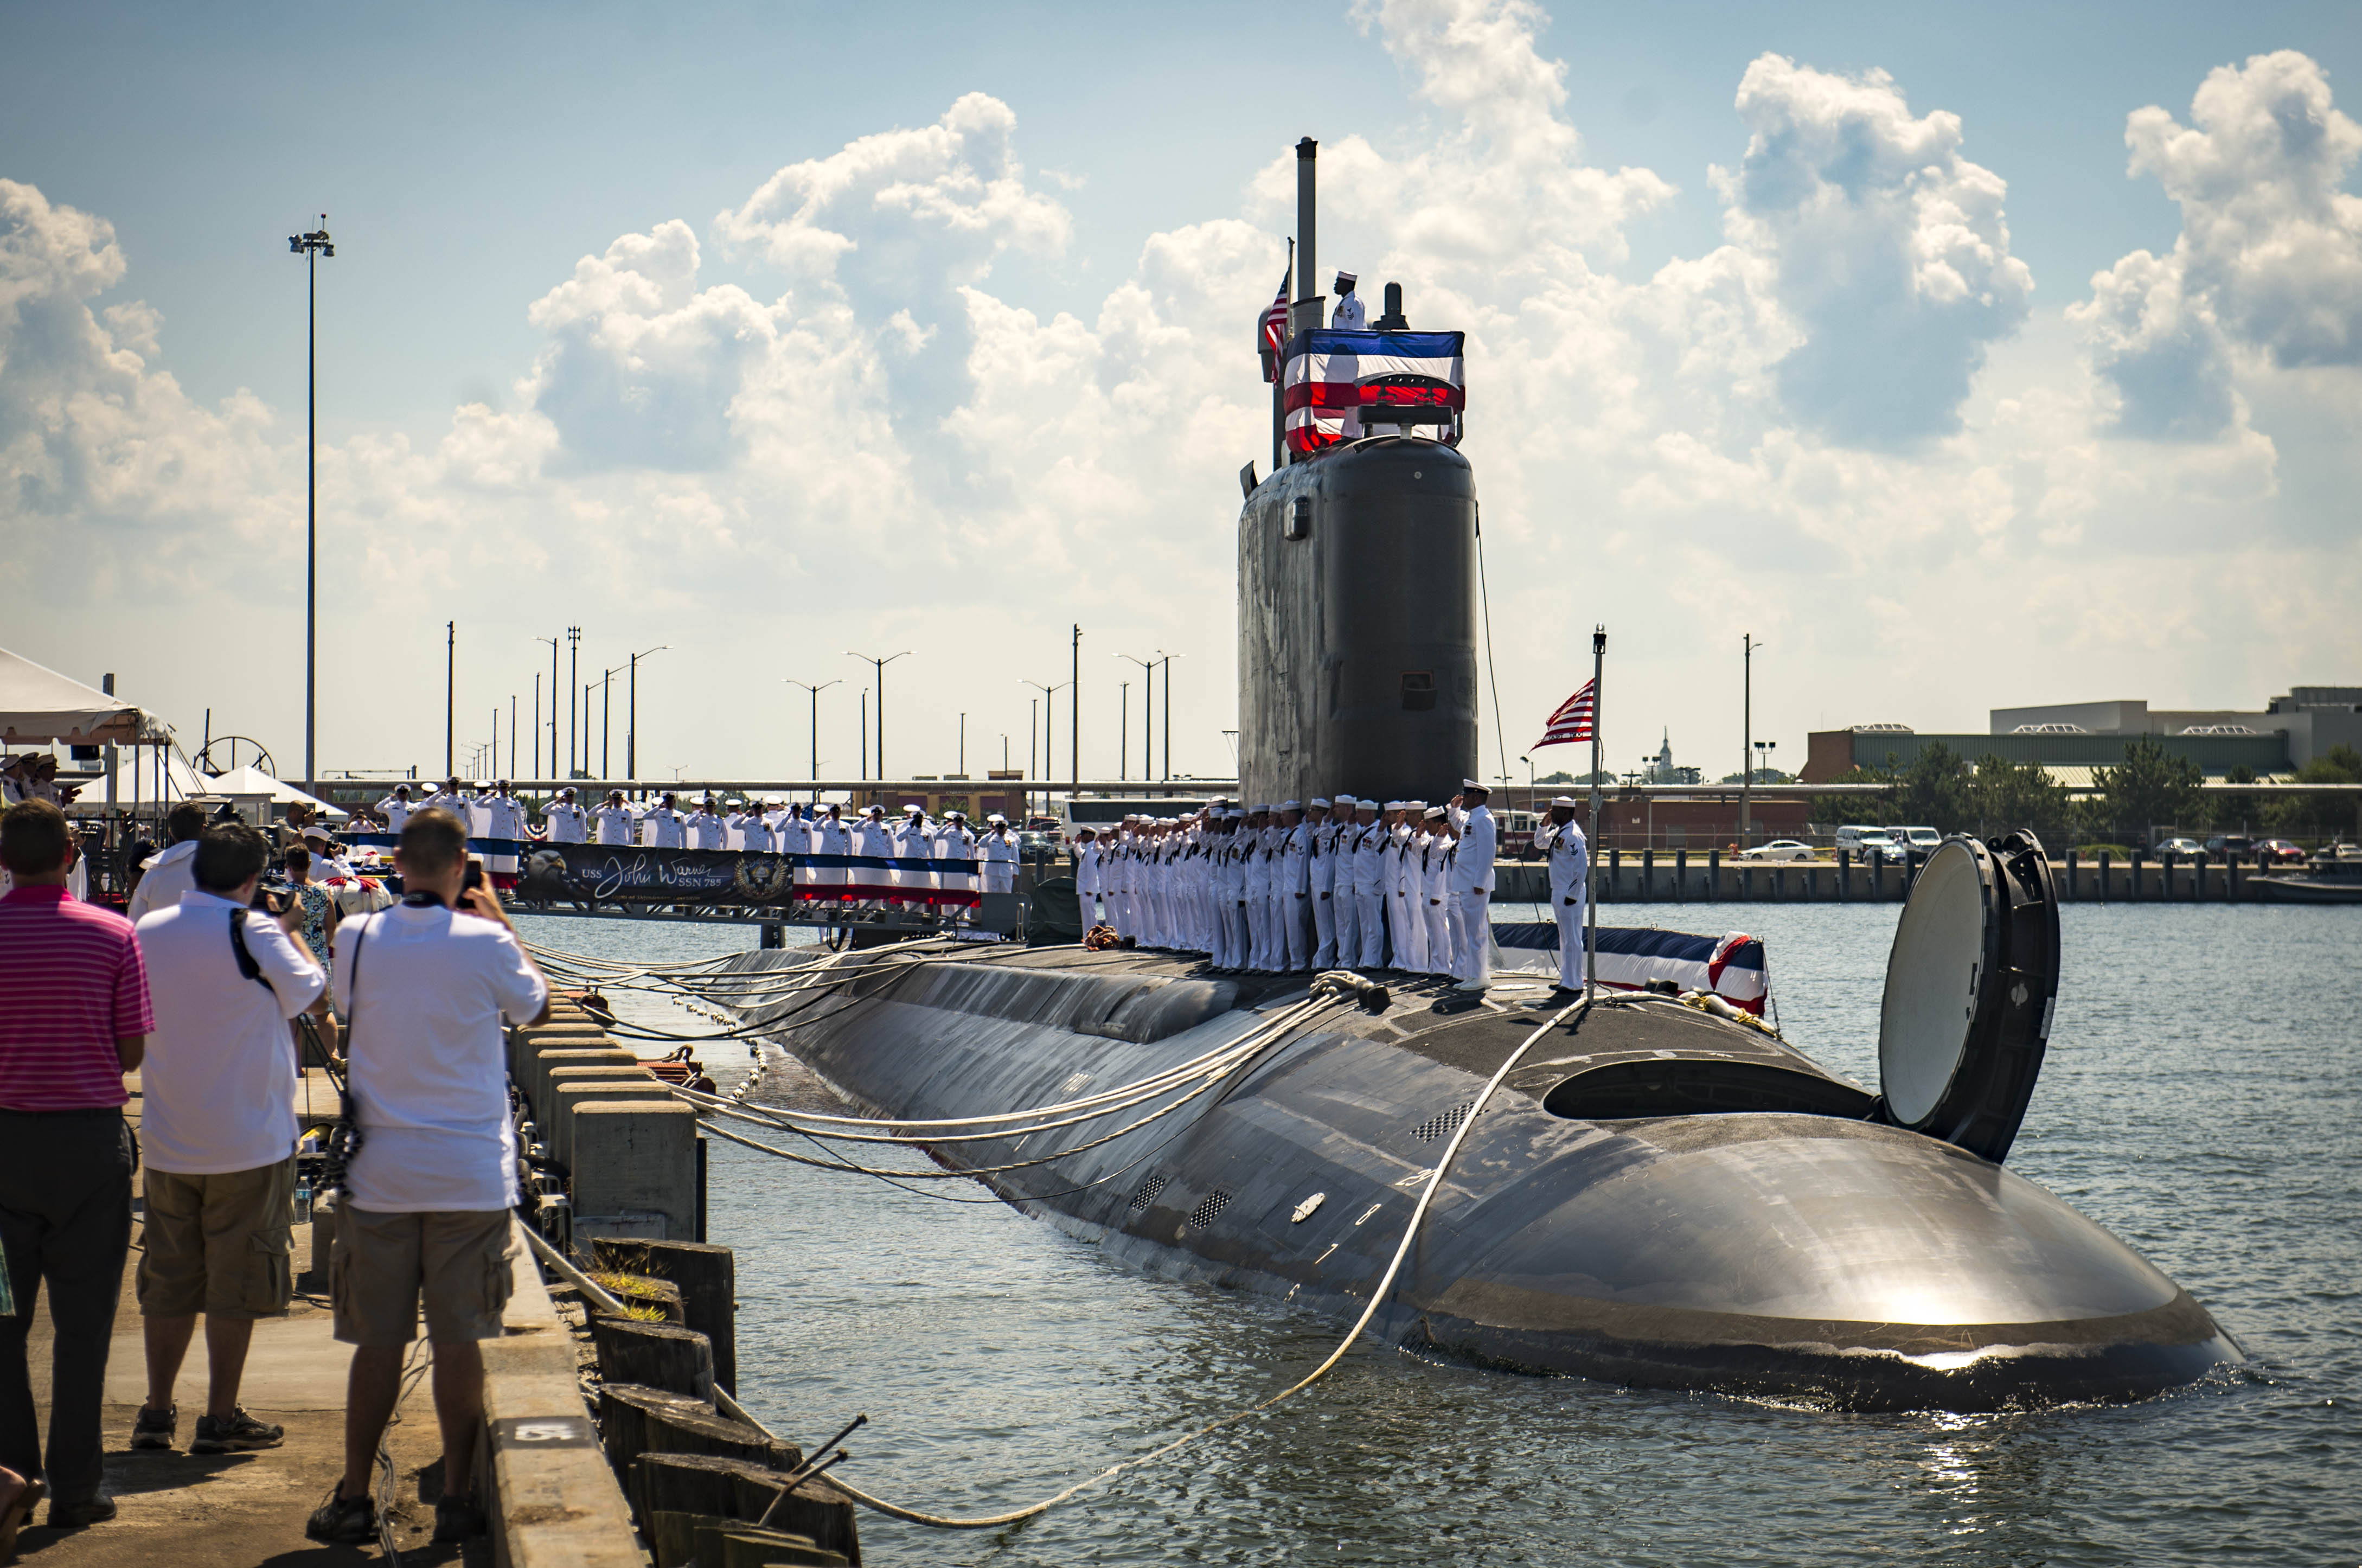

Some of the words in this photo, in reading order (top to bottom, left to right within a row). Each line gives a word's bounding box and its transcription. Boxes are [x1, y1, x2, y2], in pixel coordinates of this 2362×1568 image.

[581, 869, 602, 879] USS
[594, 854, 651, 898] John
[659, 857, 732, 885] Warner
[678, 878, 701, 887] SSN
[705, 878, 721, 887] 785
[1355, 1203, 1381, 1226] 8
[1314, 1243, 1339, 1264] 7
